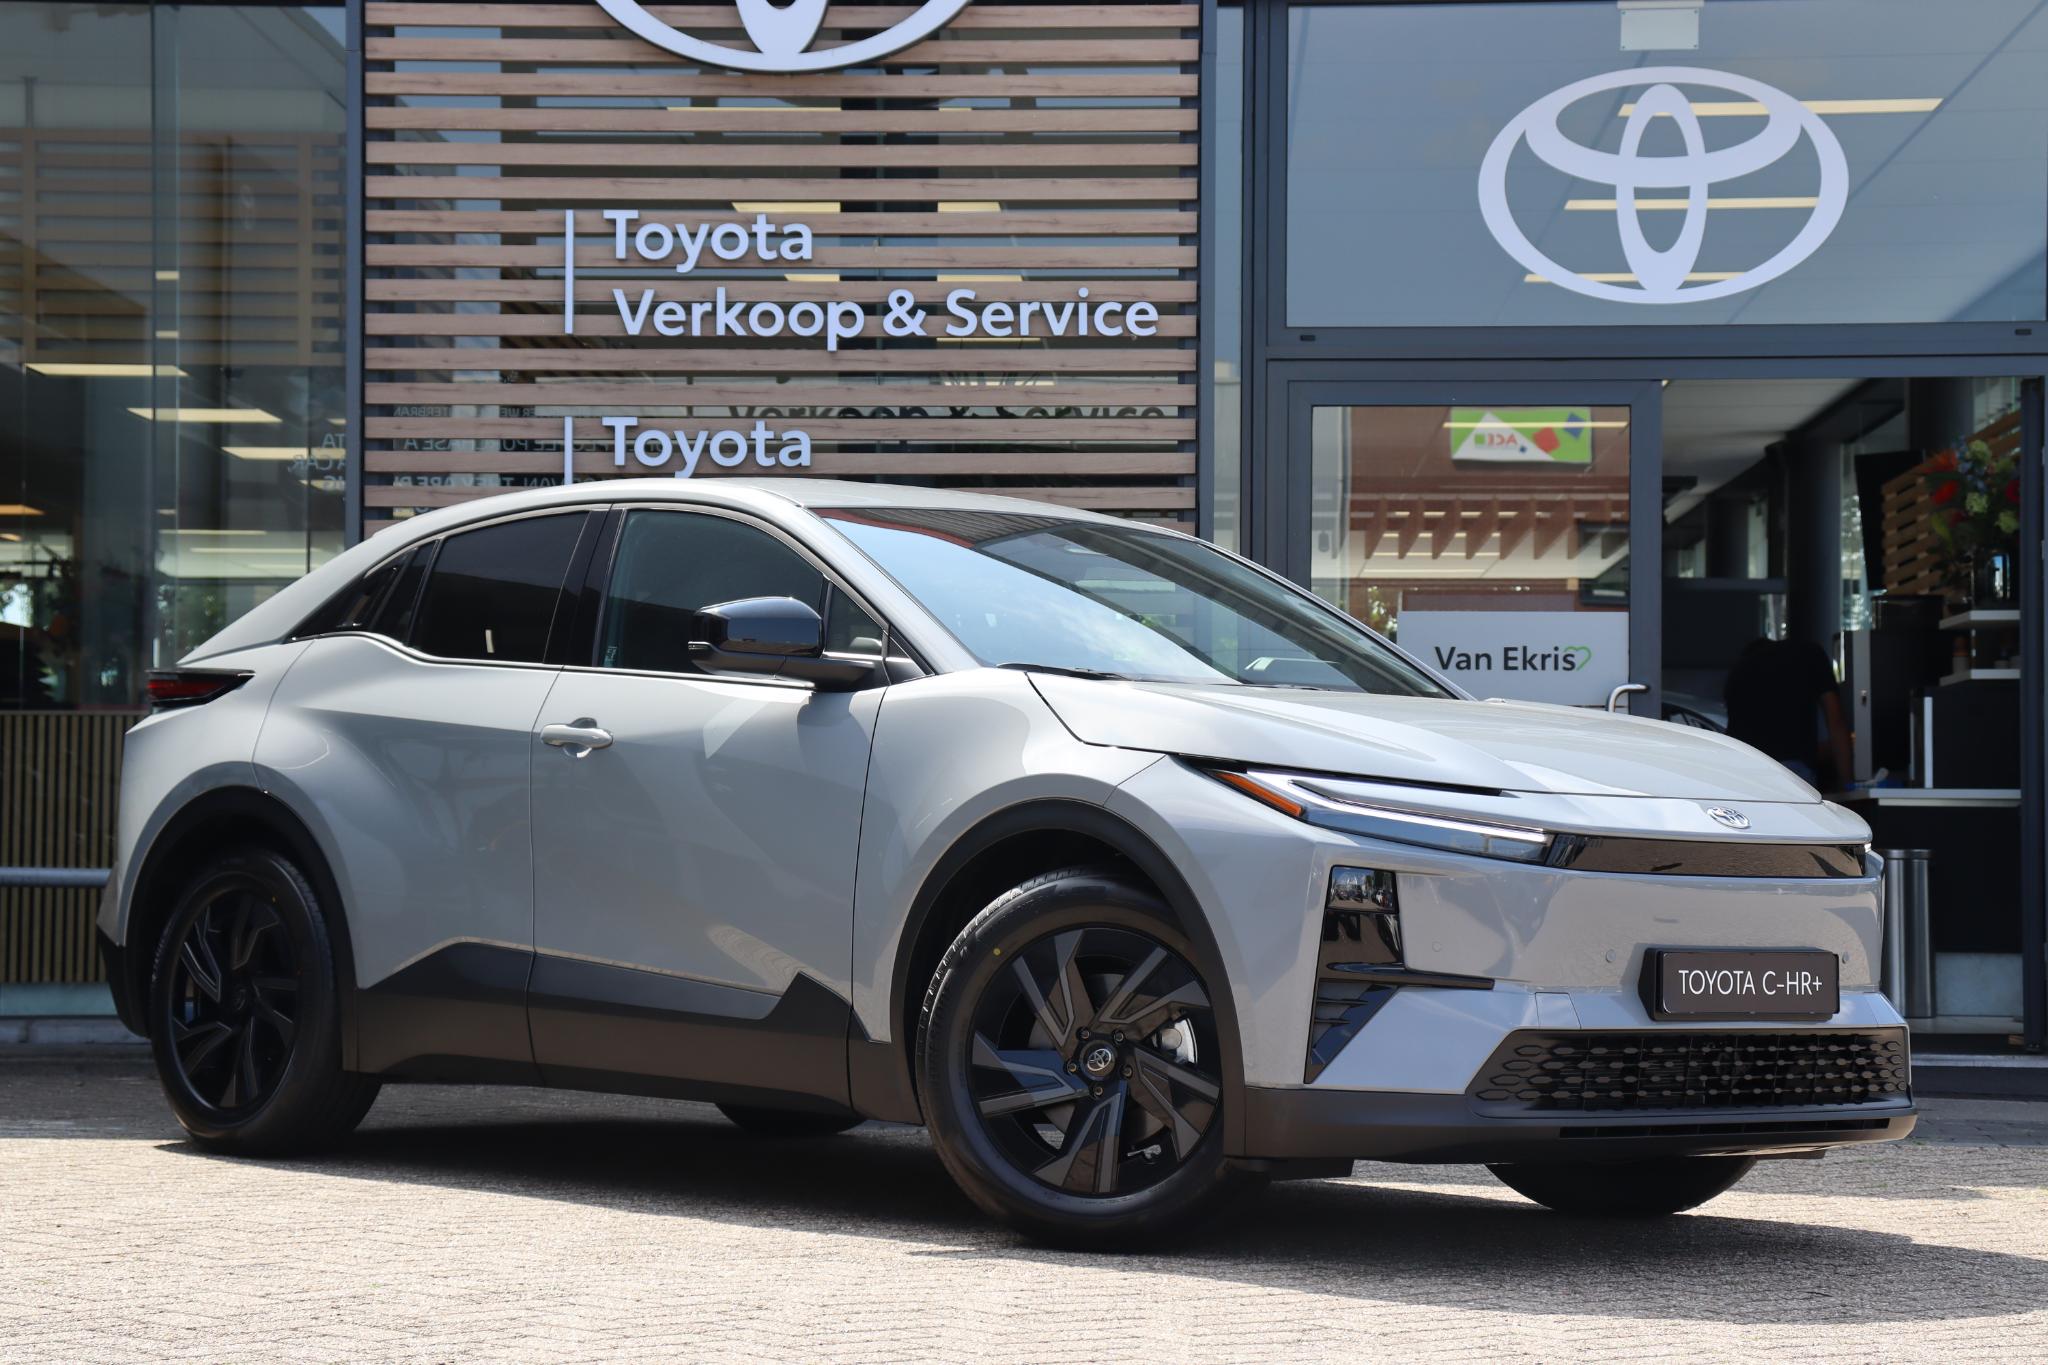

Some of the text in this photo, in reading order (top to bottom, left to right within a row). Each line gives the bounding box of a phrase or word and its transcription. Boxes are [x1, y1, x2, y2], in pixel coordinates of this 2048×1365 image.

[602, 209, 814, 274] Toyota
[612, 286, 1159, 352] Verkoop & Service
[601, 416, 812, 479] Toyota
[1434, 645, 1577, 672] Van Ekris
[1678, 969, 1823, 996] TOYOTA C-HR+
